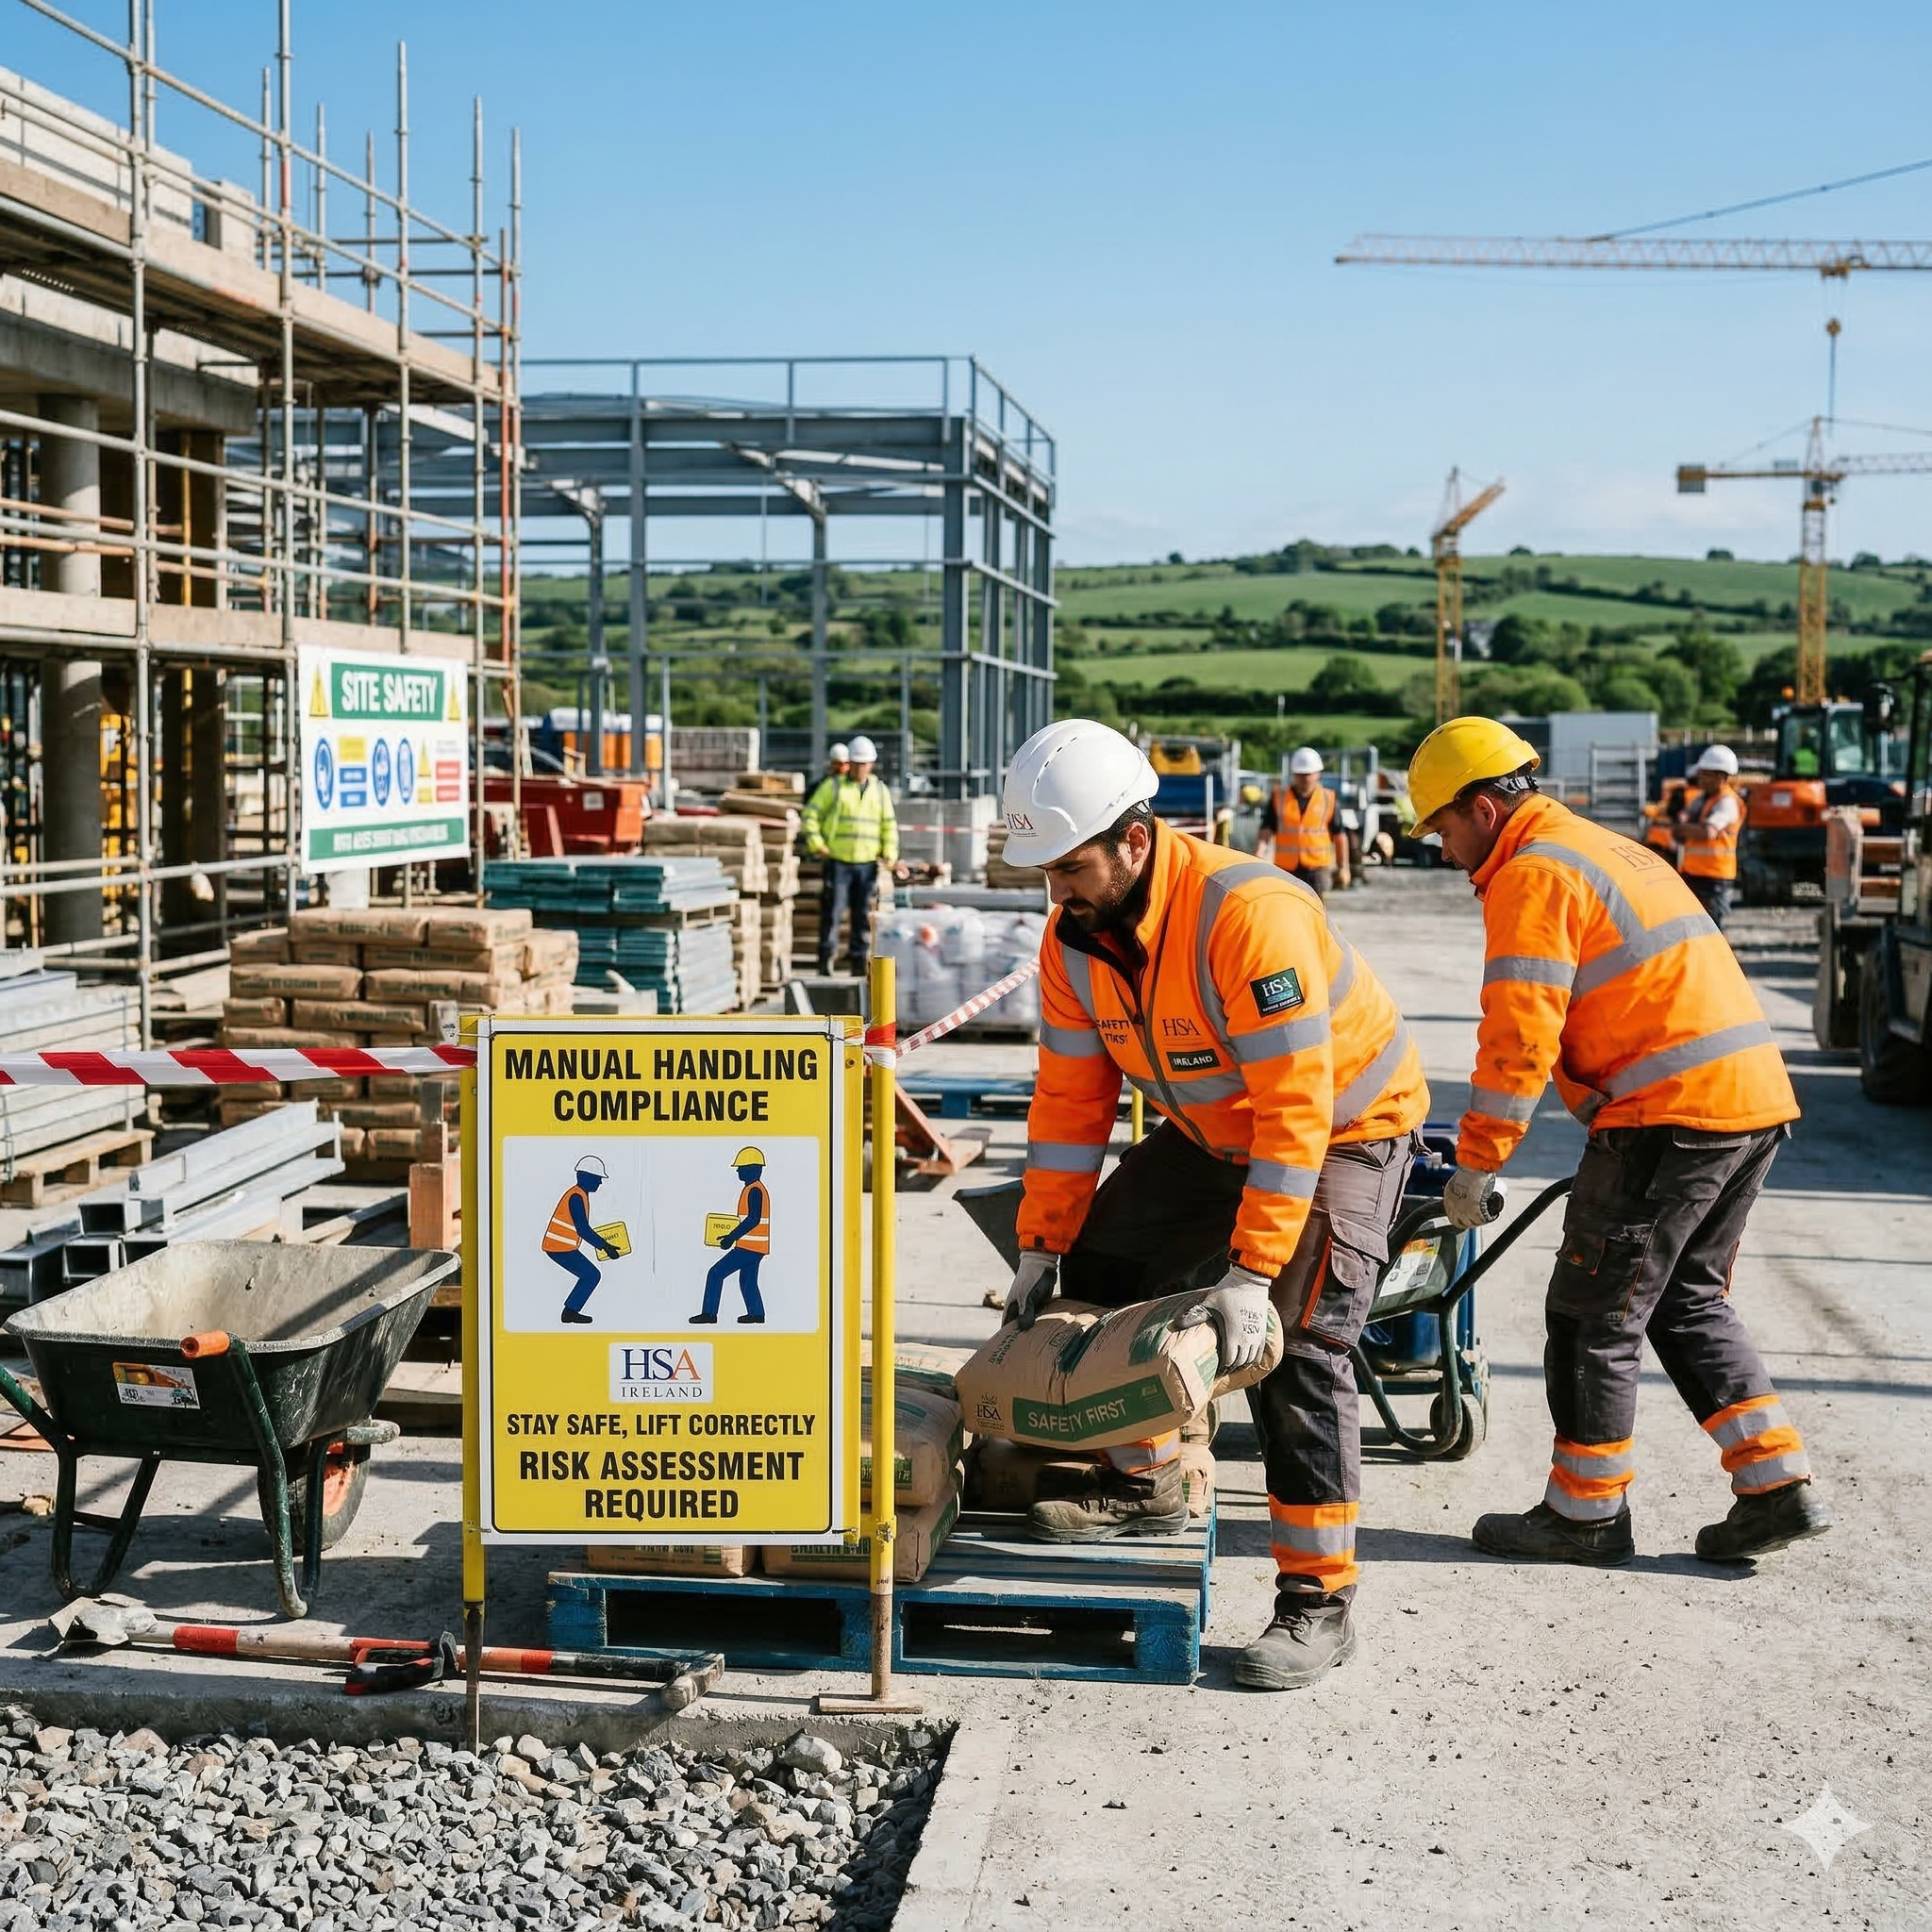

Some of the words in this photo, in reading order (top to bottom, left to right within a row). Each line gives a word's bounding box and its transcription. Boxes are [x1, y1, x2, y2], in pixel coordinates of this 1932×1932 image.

[341, 670, 381, 712] SITE
[383, 673, 438, 714] SAFETY
[1261, 976, 1293, 997] HSA
[1162, 1018, 1200, 1037] HSA
[505, 1048, 641, 1081] MANUAL
[654, 1048, 818, 1081] HANDLING
[554, 1090, 769, 1123] COMPLIANCE
[621, 1348, 702, 1381] HSA
[622, 1387, 703, 1398] IRELAND
[507, 1413, 559, 1436] STAY
[566, 1413, 628, 1440] SAFE,
[636, 1413, 682, 1436] LIFT
[689, 1413, 816, 1436] CORRECTLY
[1027, 1411, 1083, 1433] SAFETY
[1085, 1398, 1126, 1426] FIRST
[520, 1450, 591, 1481] RISK
[600, 1450, 805, 1481] ASSESSMENT
[585, 1489, 739, 1523] REQUIRED
